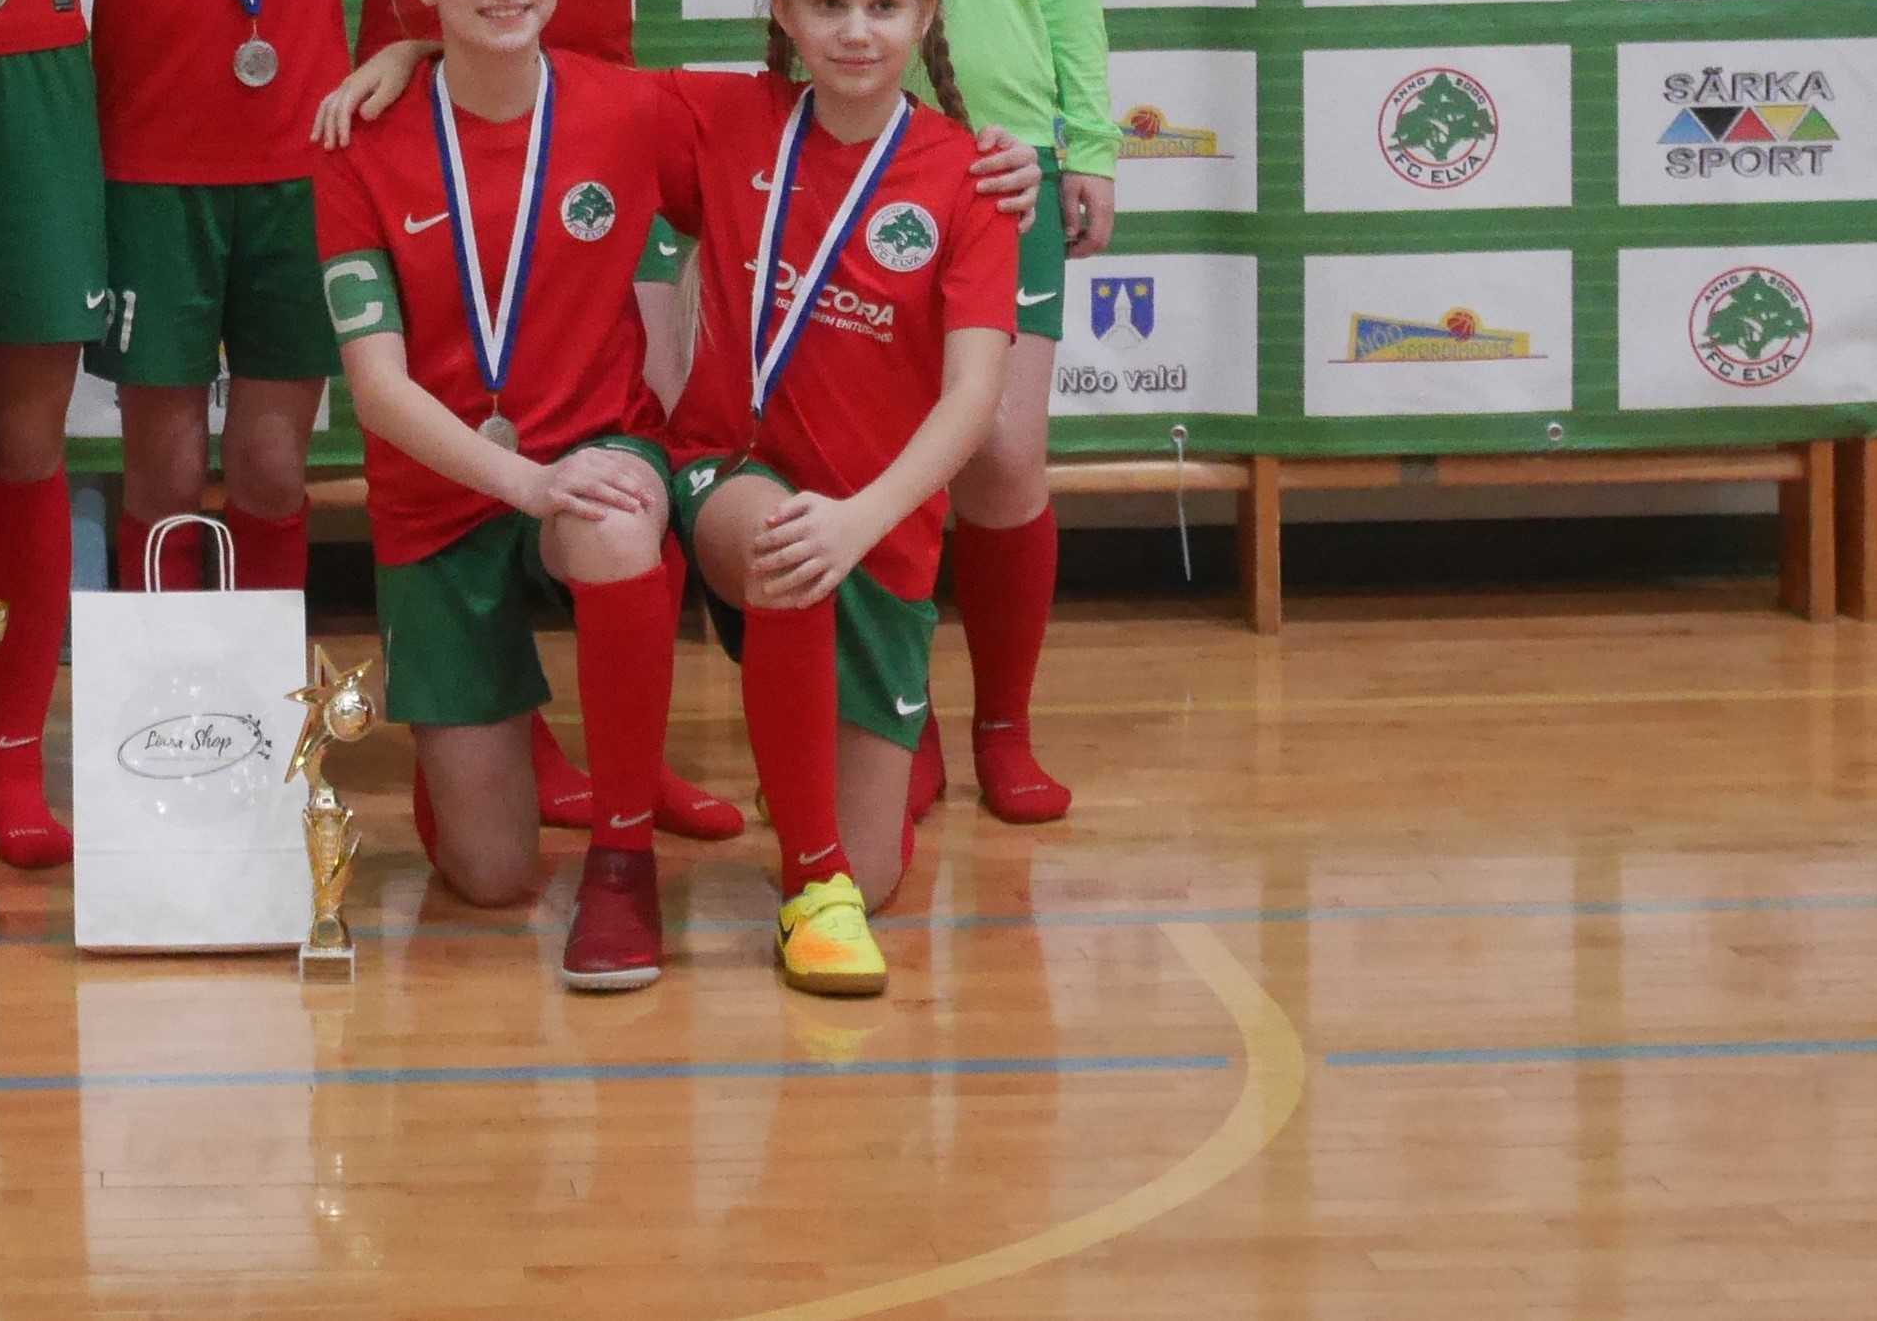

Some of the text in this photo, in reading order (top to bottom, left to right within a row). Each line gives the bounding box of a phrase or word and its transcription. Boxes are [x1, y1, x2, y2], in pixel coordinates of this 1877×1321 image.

[1393, 76, 1426, 106] ANNO
[1662, 66, 1835, 103] SÄRKA
[1395, 153, 1483, 184] FC ELVA
[1665, 145, 1834, 179] SPORT
[323, 259, 383, 334] C
[744, 258, 894, 326] DCORA
[1705, 275, 1738, 302] ANNO
[1057, 365, 1187, 395] Nõo vald
[1706, 351, 1796, 381] FC ELVA
[191, 724, 232, 757] Shop
